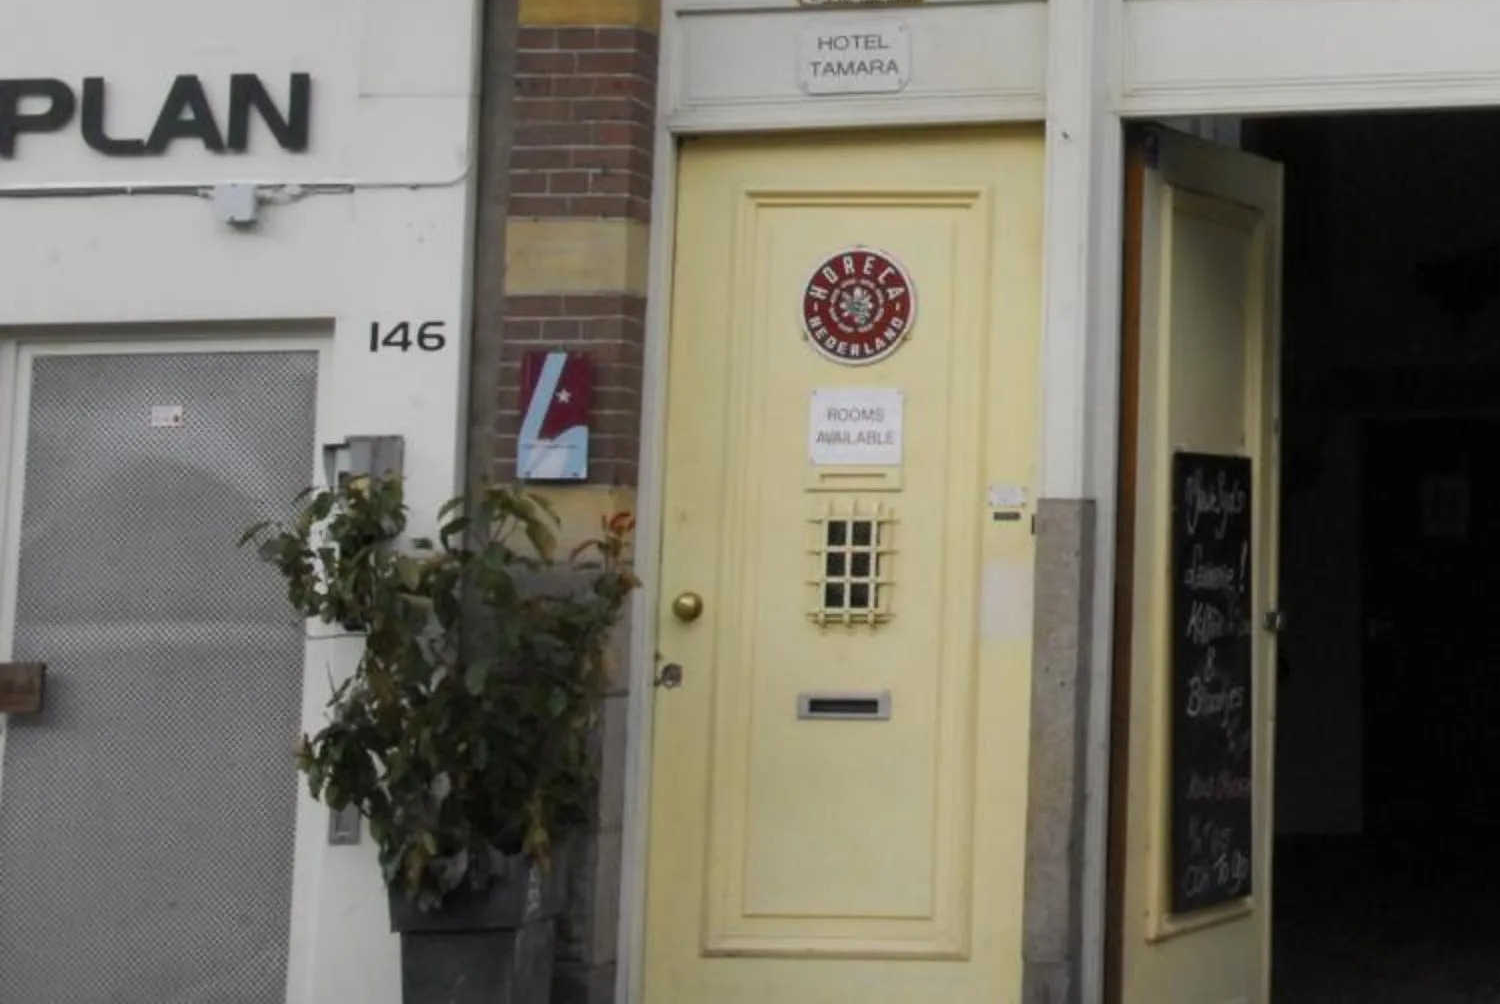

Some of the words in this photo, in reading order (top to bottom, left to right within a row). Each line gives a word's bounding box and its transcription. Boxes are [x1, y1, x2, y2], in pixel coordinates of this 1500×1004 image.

[817, 34, 889, 52] HOTEL
[809, 58, 900, 79] TAMARA
[0, 72, 312, 161] PLAN
[808, 255, 905, 301] HORECA
[369, 320, 447, 353] 146
[807, 315, 904, 357] NEDERLAND
[827, 407, 885, 423] ROOMS
[815, 430, 895, 446] AVAILABLE
